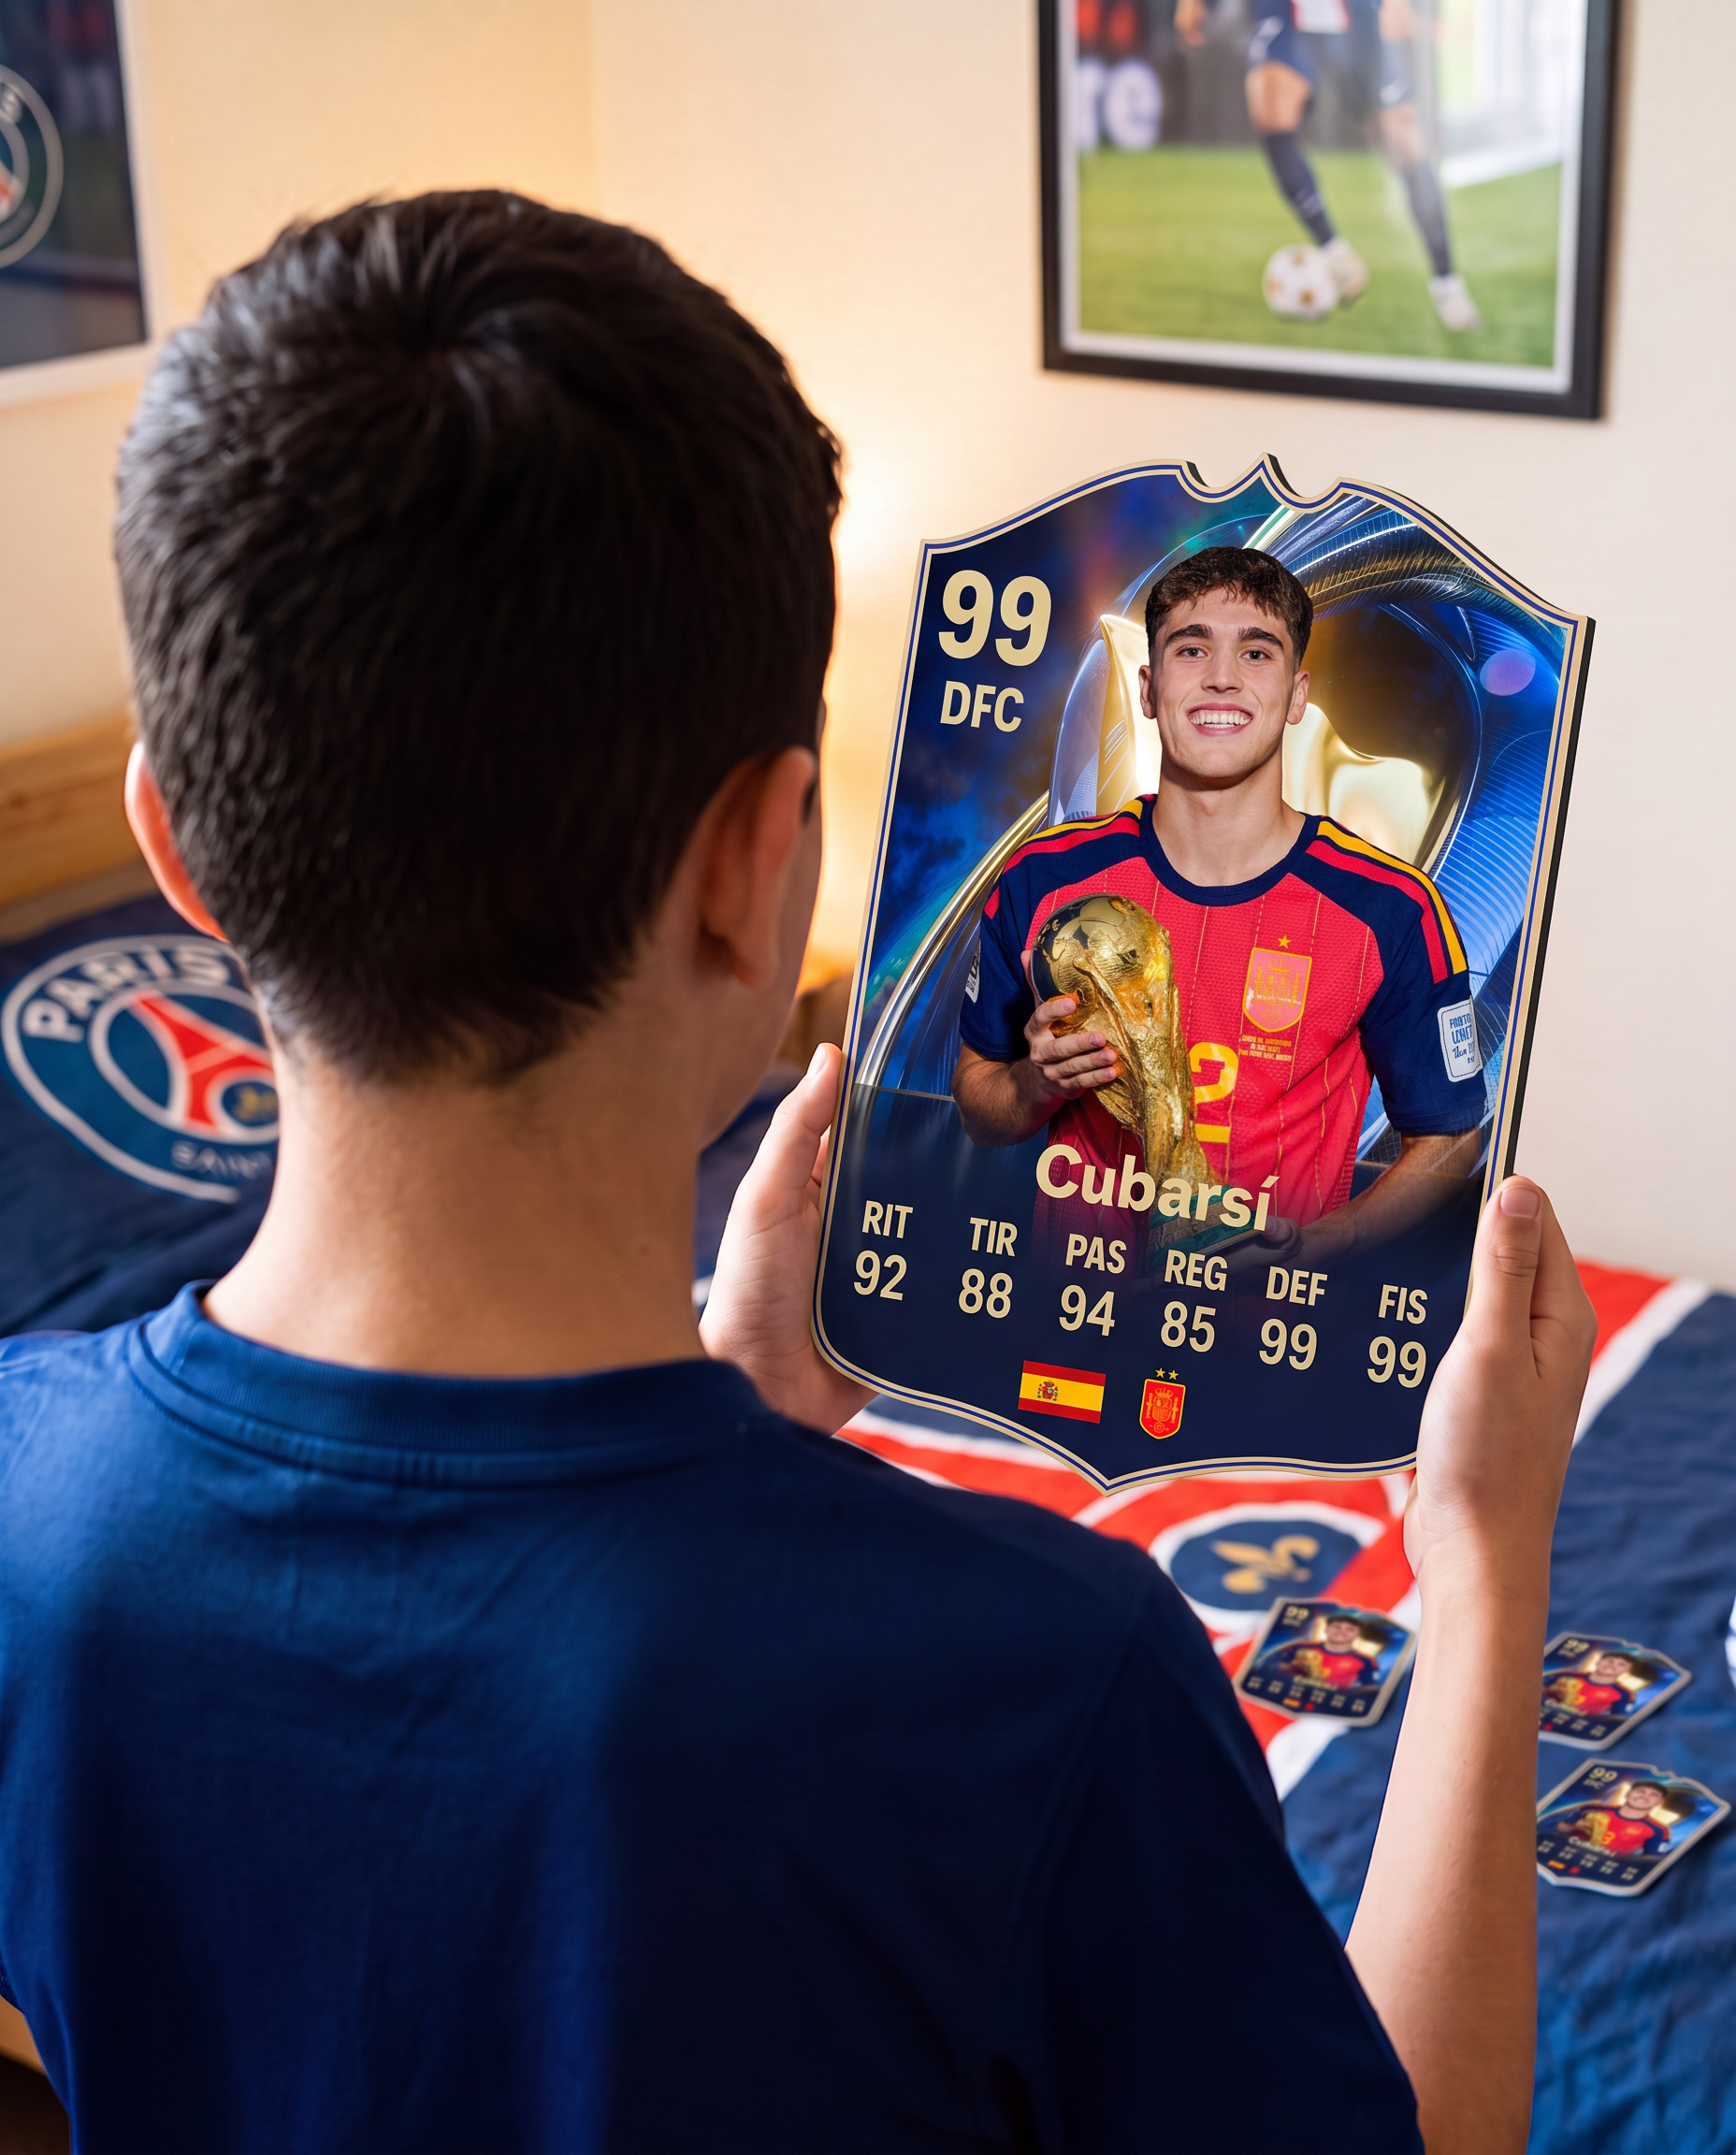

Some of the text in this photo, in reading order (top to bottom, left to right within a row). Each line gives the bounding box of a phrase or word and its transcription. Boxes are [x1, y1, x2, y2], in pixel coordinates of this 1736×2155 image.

[938, 570, 1051, 667] 99
[940, 680, 1024, 732] DFC
[22, 944, 230, 1043] PARIS
[1035, 1144, 1280, 1232] Cubarsí
[861, 1200, 1428, 1324] RIT TIR PAS REG DEF FIS
[853, 1250, 1427, 1388] 92 88 94 85 99 99
[1589, 1766, 1618, 1783] 99
